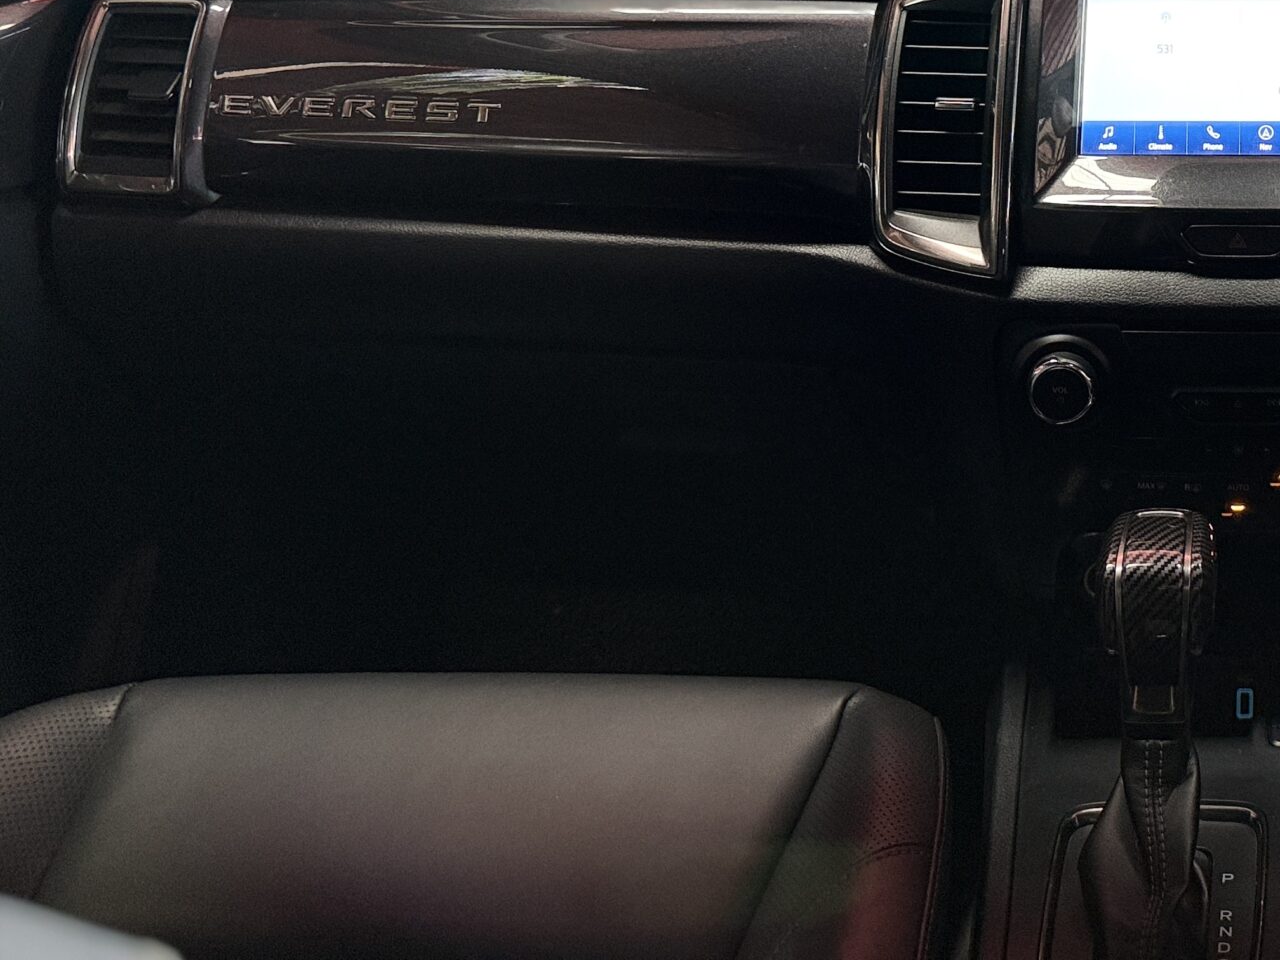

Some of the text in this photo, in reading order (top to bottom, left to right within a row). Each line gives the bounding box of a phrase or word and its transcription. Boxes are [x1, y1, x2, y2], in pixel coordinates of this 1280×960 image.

[1156, 43, 1174, 54] 531
[217, 93, 502, 124] EVEREST
[1098, 142, 1117, 151] Audio
[1148, 142, 1173, 151] Climate
[1202, 142, 1223, 151] Phone
[1258, 142, 1273, 151] Nav
[1222, 873, 1234, 884] P
[1220, 909, 1233, 921] R
[1219, 926, 1233, 937] N
[1217, 942, 1231, 953] D
